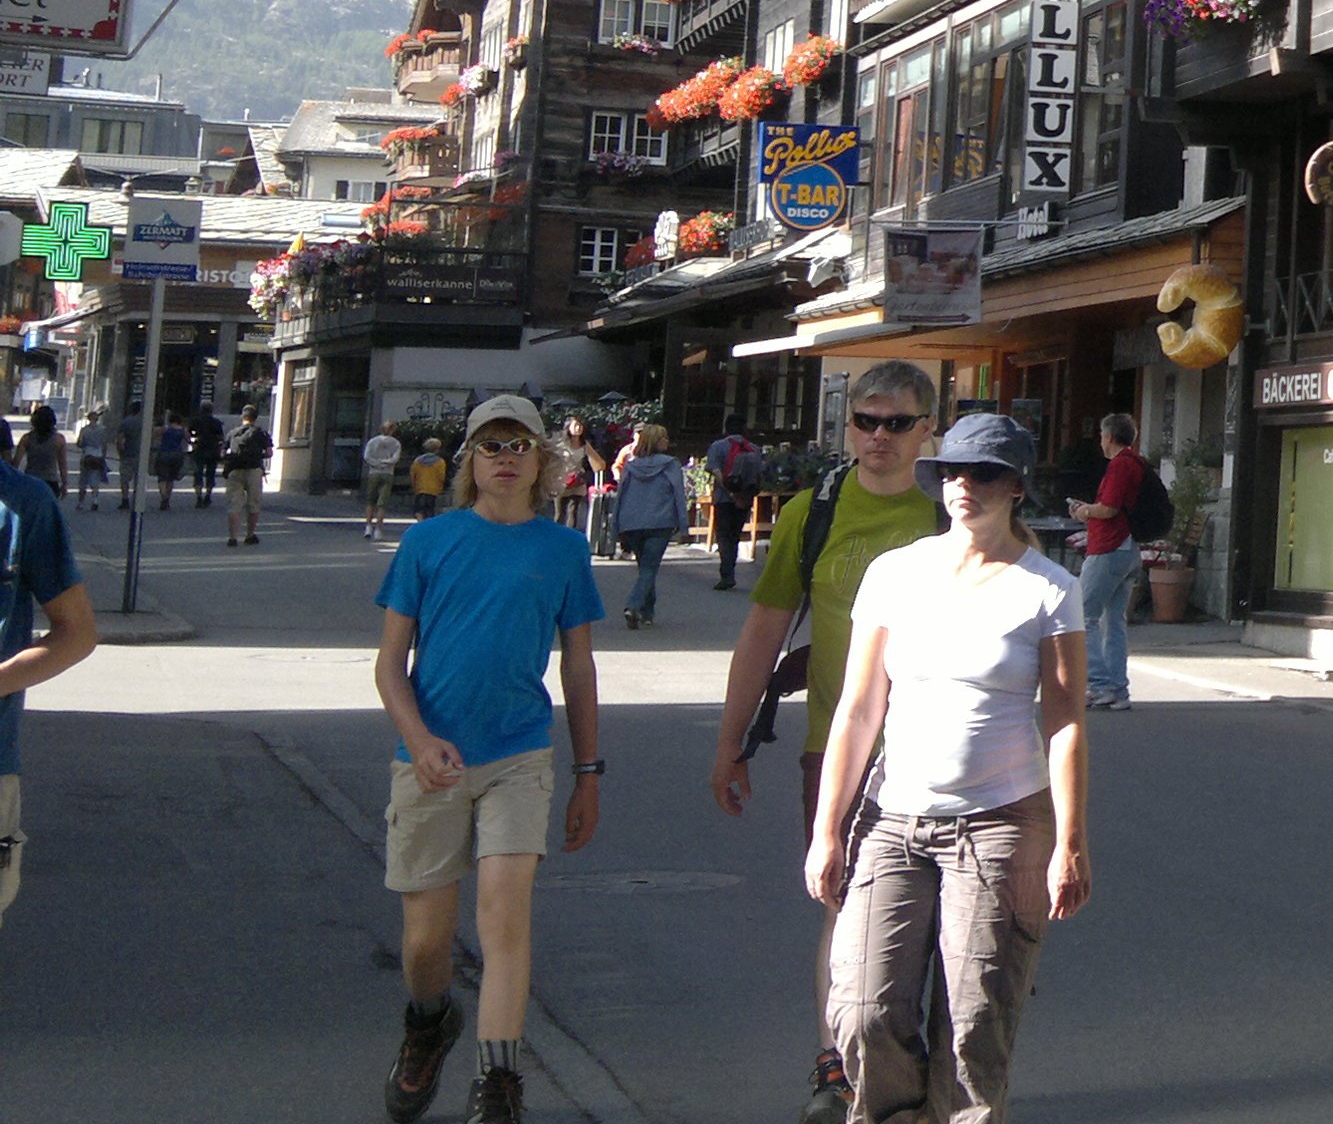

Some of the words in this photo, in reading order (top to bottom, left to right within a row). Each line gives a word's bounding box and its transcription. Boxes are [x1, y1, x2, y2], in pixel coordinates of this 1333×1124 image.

[767, 126, 794, 136] THE
[763, 129, 857, 175] Pollux
[777, 183, 840, 206] T-BAR
[786, 207, 830, 218] DISCO
[1017, 200, 1050, 241] Hotel
[139, 225, 189, 237] ZERMATT
[387, 278, 473, 289] walliserkanne
[1262, 371, 1322, 404] BÄCKEREI
